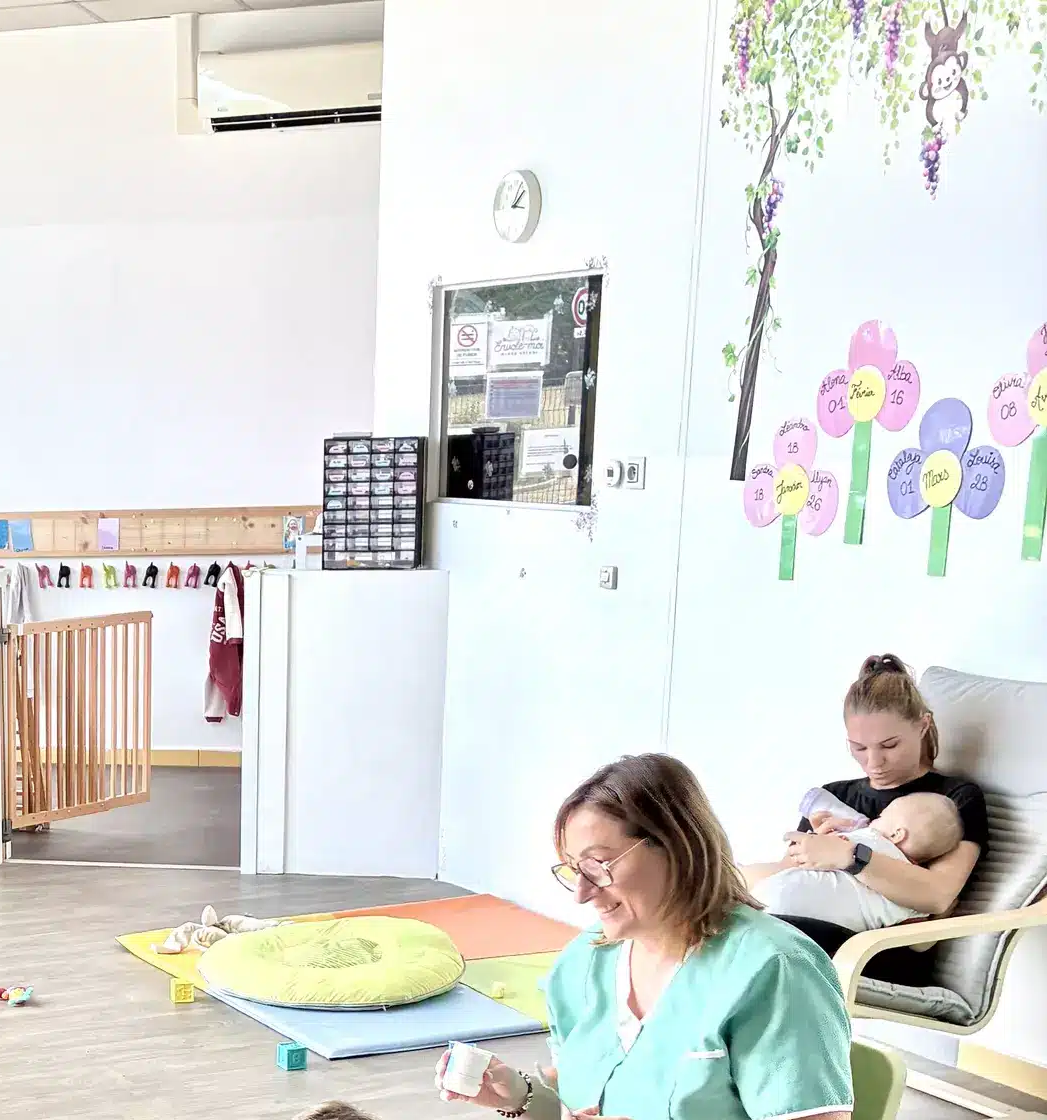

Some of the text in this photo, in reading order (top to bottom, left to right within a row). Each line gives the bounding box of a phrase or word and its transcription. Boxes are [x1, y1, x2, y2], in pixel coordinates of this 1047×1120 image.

[828, 396, 846, 413] 01
[890, 389, 905, 406] 16
[1000, 401, 1017, 420] 08
[787, 442, 799, 454] 18
[900, 480, 915, 496] 01
[970, 473, 990, 492] 28
[754, 488, 765, 501] 18
[806, 494, 823, 511] 26
